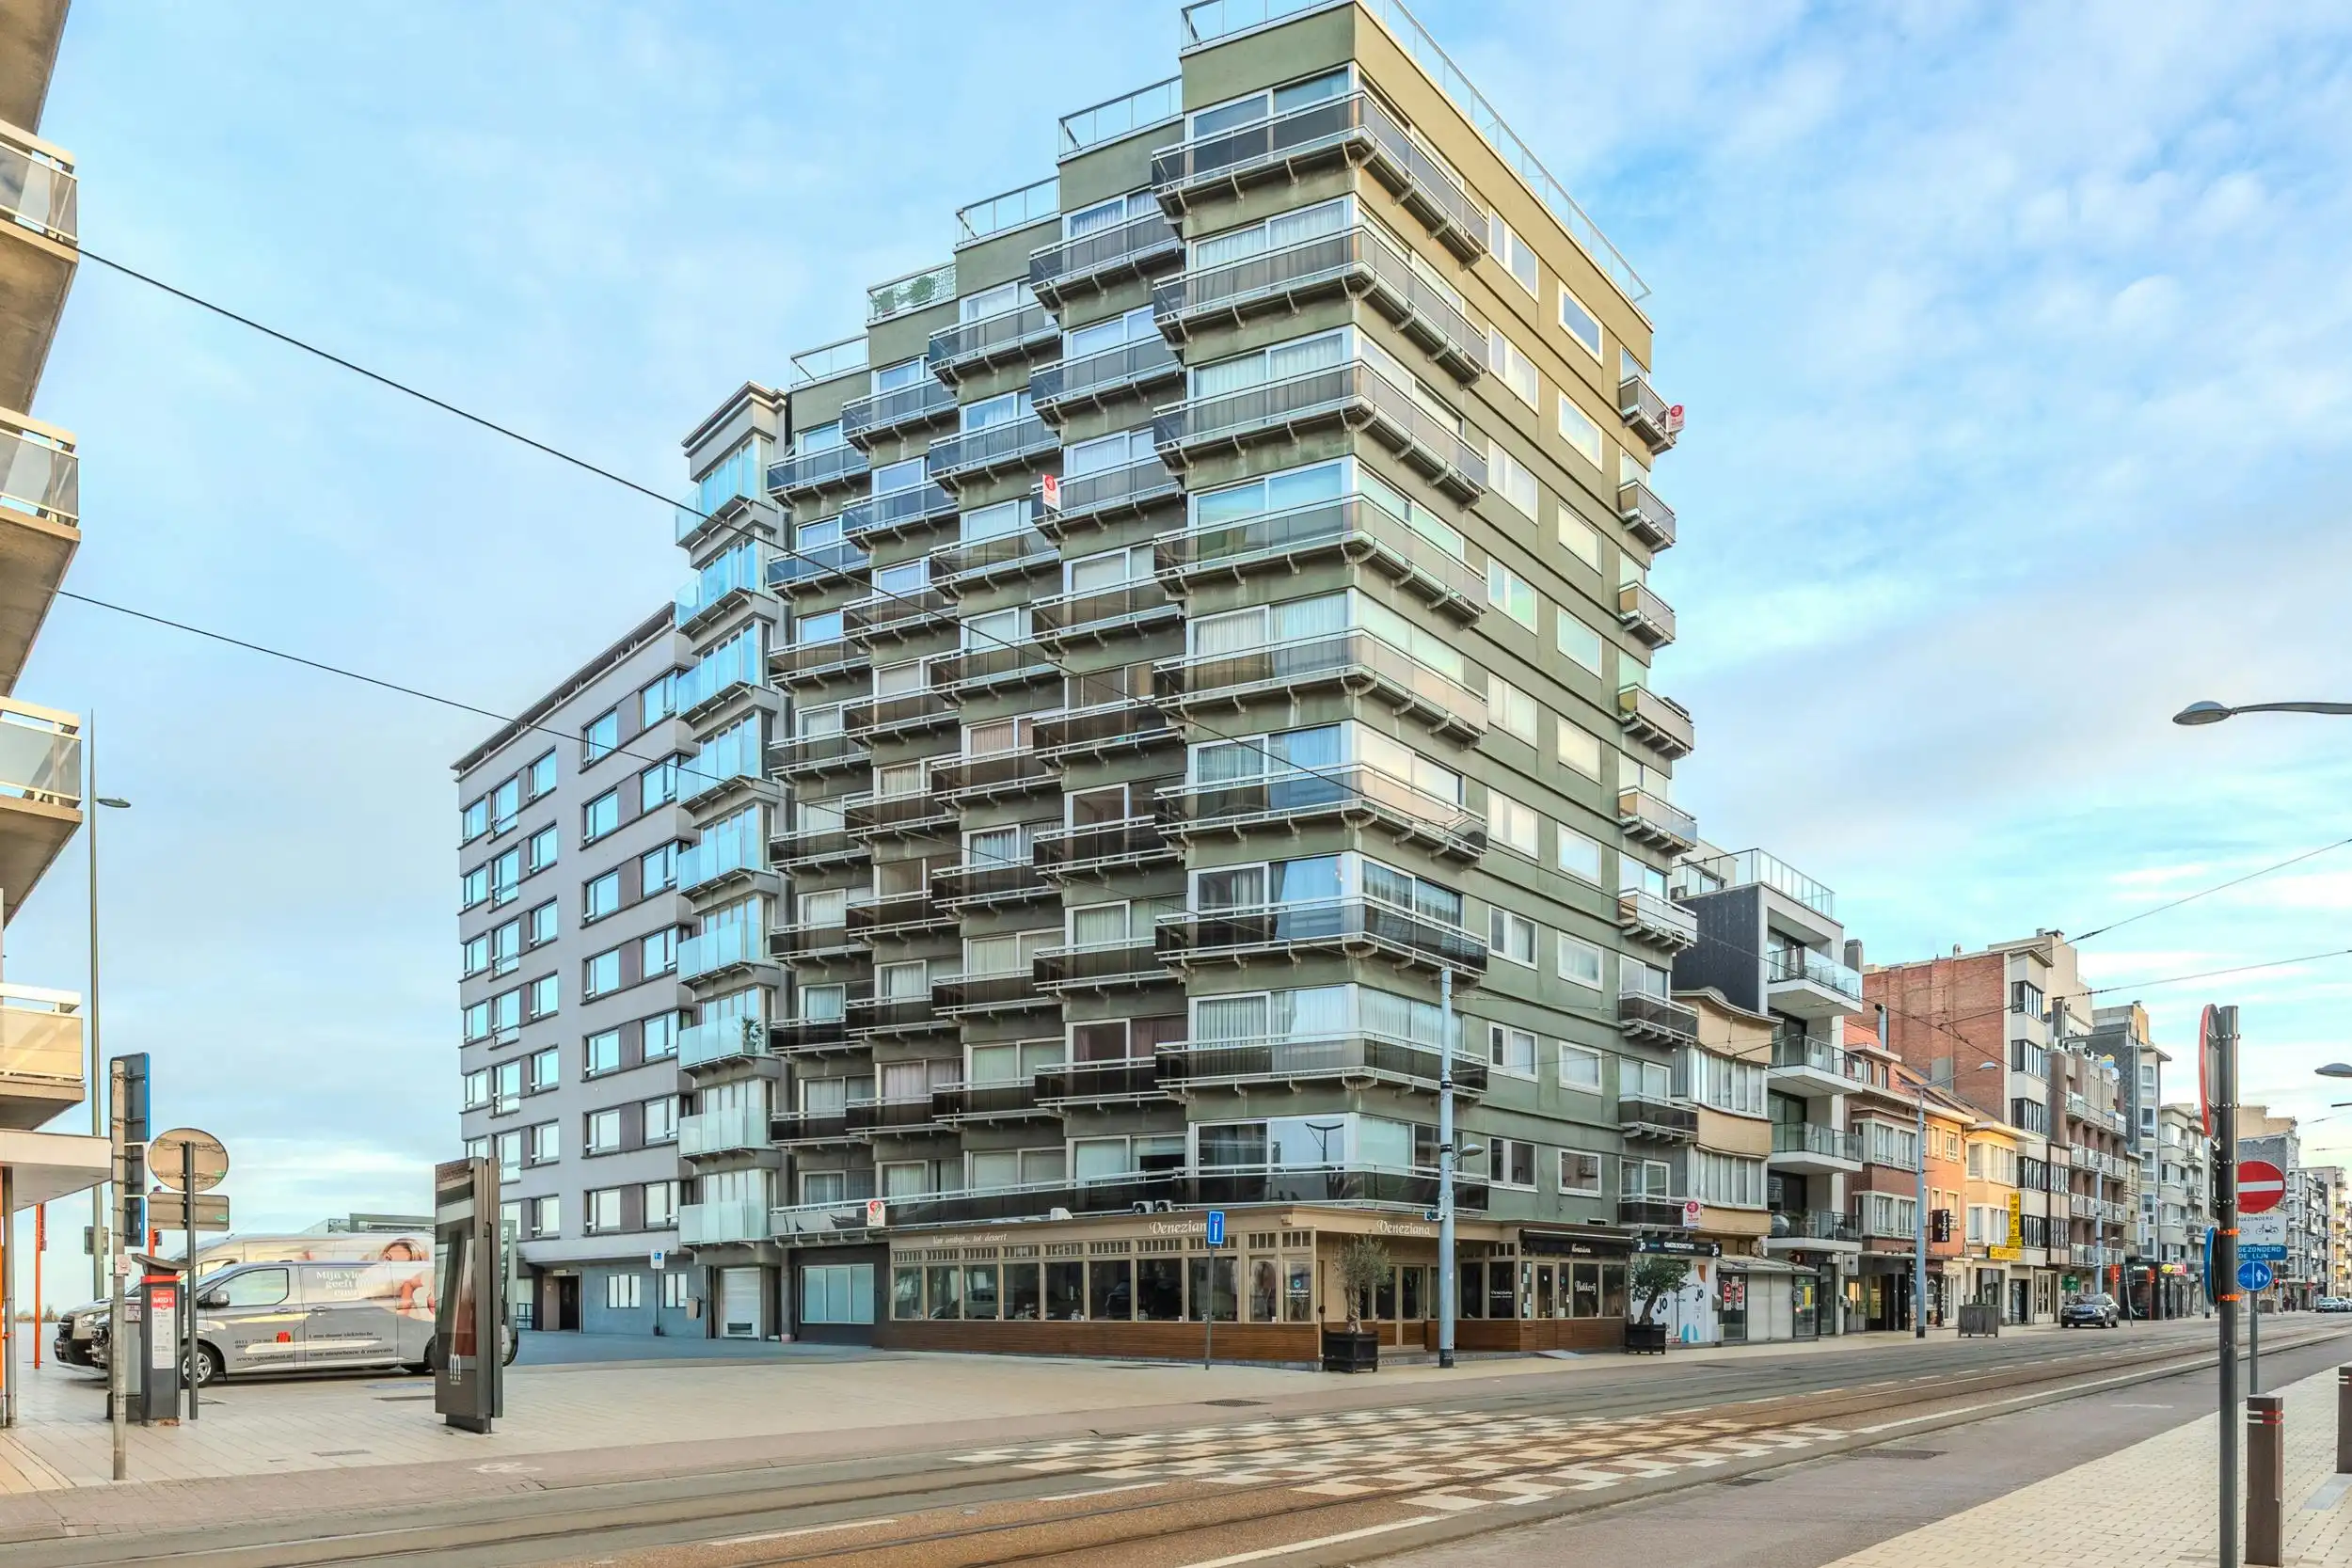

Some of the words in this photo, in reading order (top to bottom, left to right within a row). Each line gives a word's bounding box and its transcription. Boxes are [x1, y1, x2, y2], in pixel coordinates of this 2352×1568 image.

[1148, 1220, 1207, 1234] Venezian
[1376, 1219, 1431, 1235] Veneziana
[316, 1271, 341, 1281] Mijn
[326, 1279, 353, 1290] geeft
[1657, 1298, 1668, 1314] JO
